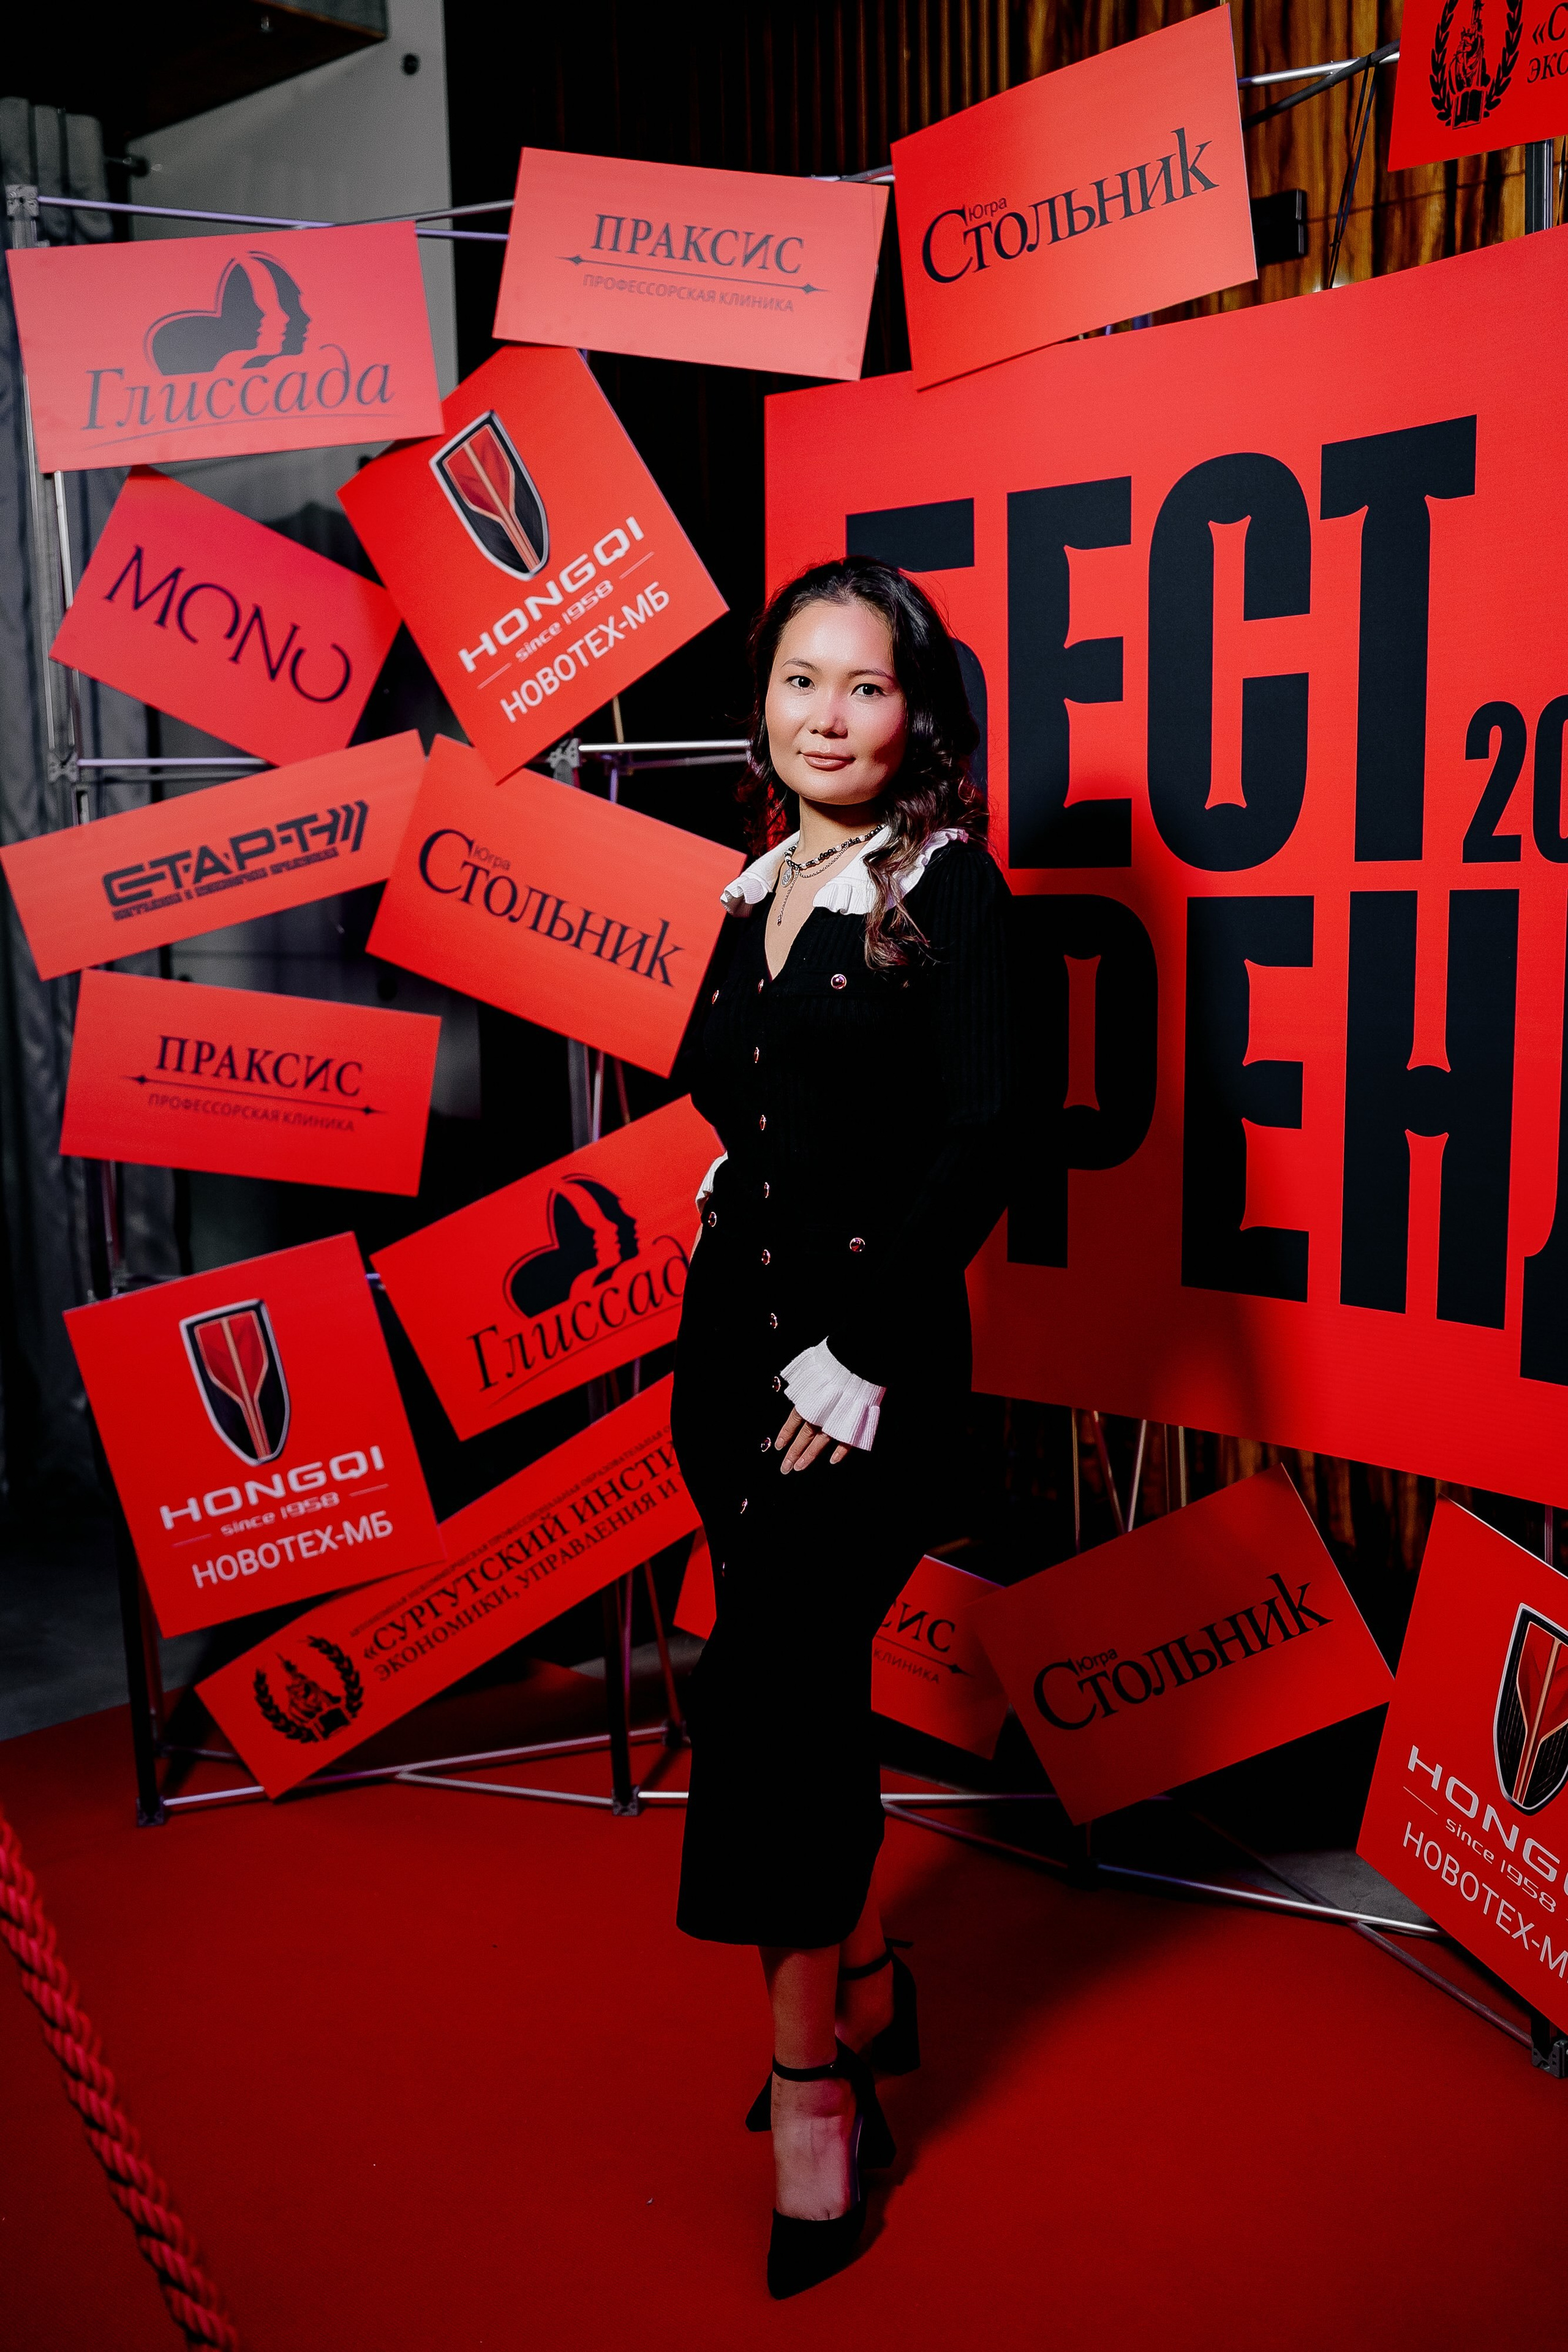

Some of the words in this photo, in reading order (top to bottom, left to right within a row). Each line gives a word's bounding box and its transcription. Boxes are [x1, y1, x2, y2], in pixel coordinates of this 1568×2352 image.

[592, 214, 805, 274] ПРАКСИС
[922, 127, 1219, 284] Стольник
[968, 197, 1007, 221] Югра
[582, 274, 716, 303] ПРОФЕССОРСКАЯ
[718, 291, 794, 312] КЛИНИКА
[80, 344, 394, 430] Глиссада
[458, 516, 644, 673] HONGQI
[515, 622, 563, 662] since
[562, 579, 614, 626] 1958
[500, 581, 670, 723] НОВОТЕХ-МБ
[473, 846, 511, 871] Югра
[419, 829, 684, 988] Стольник
[156, 1035, 363, 1097] ПРАКСИС
[148, 1093, 281, 1122] ПРОФЕССОРСКАЯ
[282, 1110, 355, 1131] КЛИНИКА
[159, 1446, 385, 1530] HONGQI
[221, 1512, 276, 1536] since
[281, 1491, 340, 1520] 1958
[192, 1510, 393, 1588] НОВОТЕХ-МБ
[363, 1513, 570, 1661] «СУРГУТСКИЙ
[374, 1583, 519, 1681] ЭКОНОМИКИ,
[515, 1489, 657, 1590] УПРАВЛЕНИЯ
[656, 1477, 679, 1500] И
[874, 1648, 939, 1684] КЛИНИКА
[1033, 1572, 1333, 1730] Стольник
[1076, 1648, 1118, 1673] Югра
[1408, 1745, 1568, 1895] HONG
[1403, 1821, 1568, 1985] НОВОТЕХ-М
[1446, 1819, 1494, 1864] since
[1500, 1860, 1556, 1912] 1958
